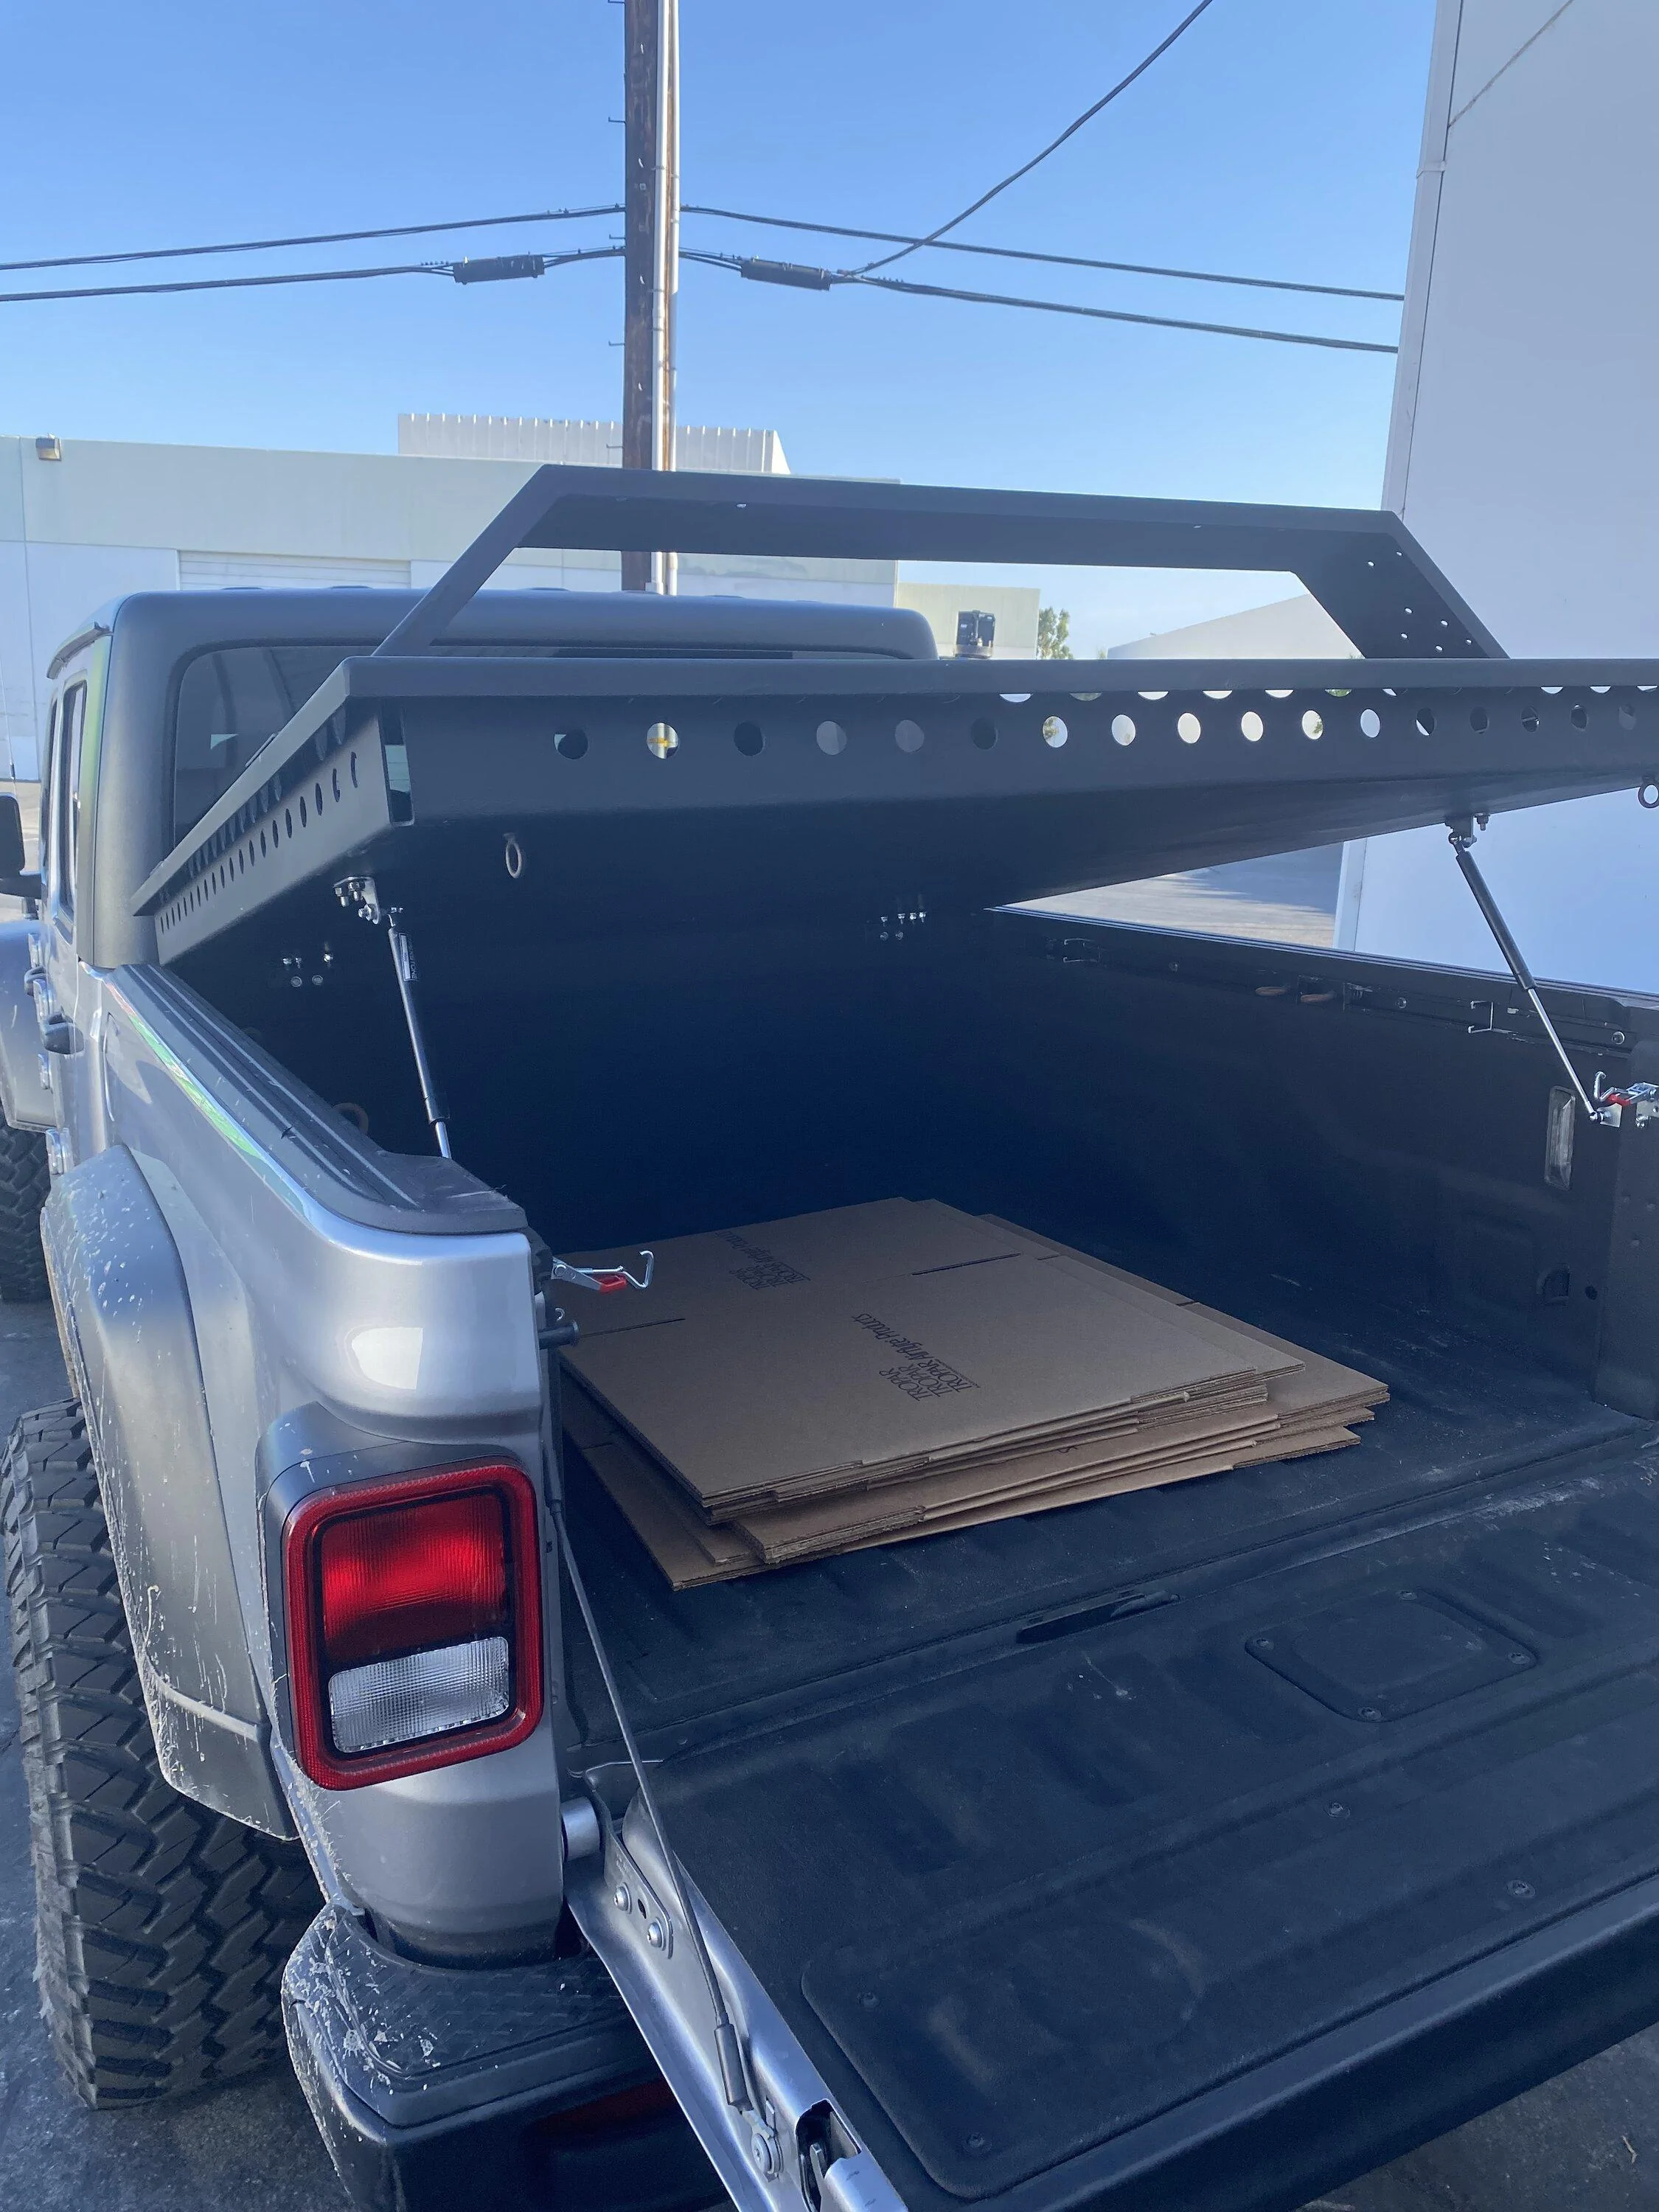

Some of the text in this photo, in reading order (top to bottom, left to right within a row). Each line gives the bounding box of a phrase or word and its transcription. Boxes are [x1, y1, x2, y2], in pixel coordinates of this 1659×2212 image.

[879, 1367, 933, 1402] TROPAR
[898, 1363, 953, 1397] TROPAR
[918, 1360, 973, 1392] TROPAR
